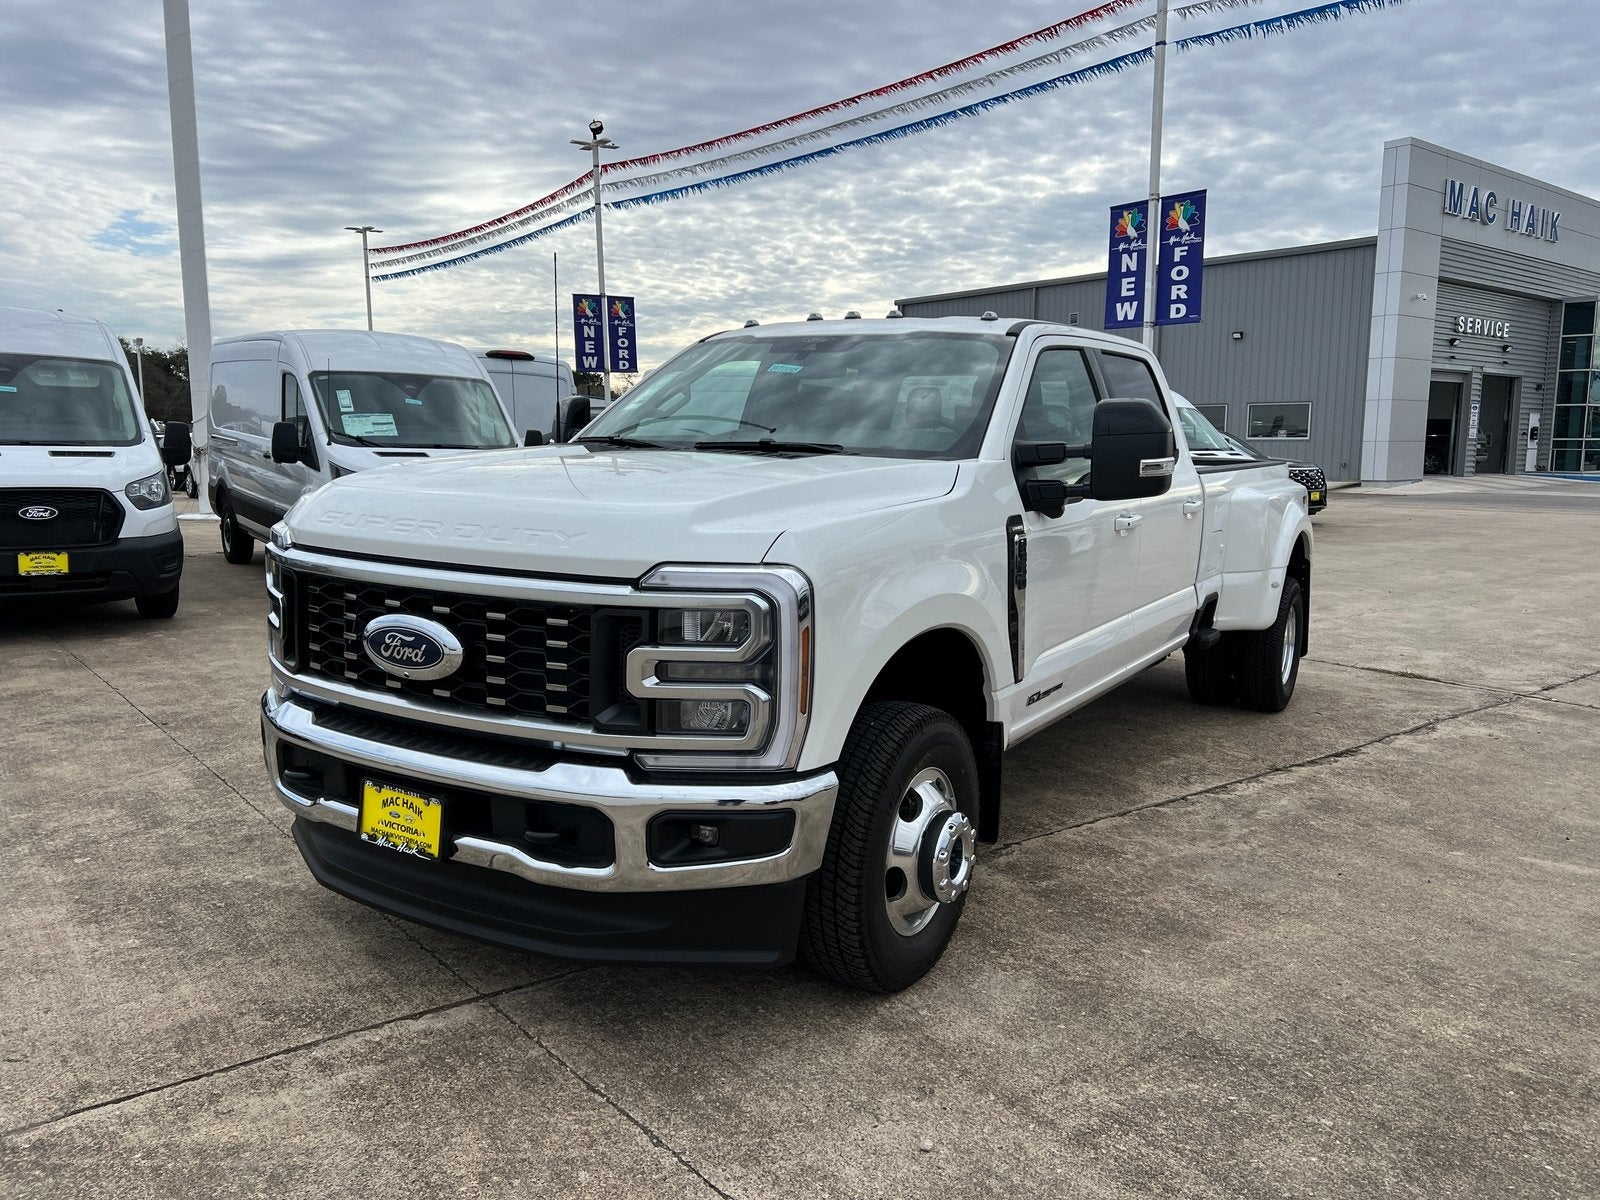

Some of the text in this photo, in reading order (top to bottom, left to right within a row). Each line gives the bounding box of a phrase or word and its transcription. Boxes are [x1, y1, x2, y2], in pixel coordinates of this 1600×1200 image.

[1444, 179, 1561, 243] MAC HAIK
[1115, 252, 1138, 320] NEW
[1169, 246, 1190, 319] FORD
[1457, 315, 1510, 338] SERVICE
[582, 325, 598, 369] NEW
[617, 326, 630, 370] FORD
[26, 508, 50, 517] Ford
[317, 510, 589, 549] SUPER DUTY
[380, 632, 427, 664] Ford
[381, 796, 423, 820] MAC HAIK
[374, 835, 397, 850] Mac
